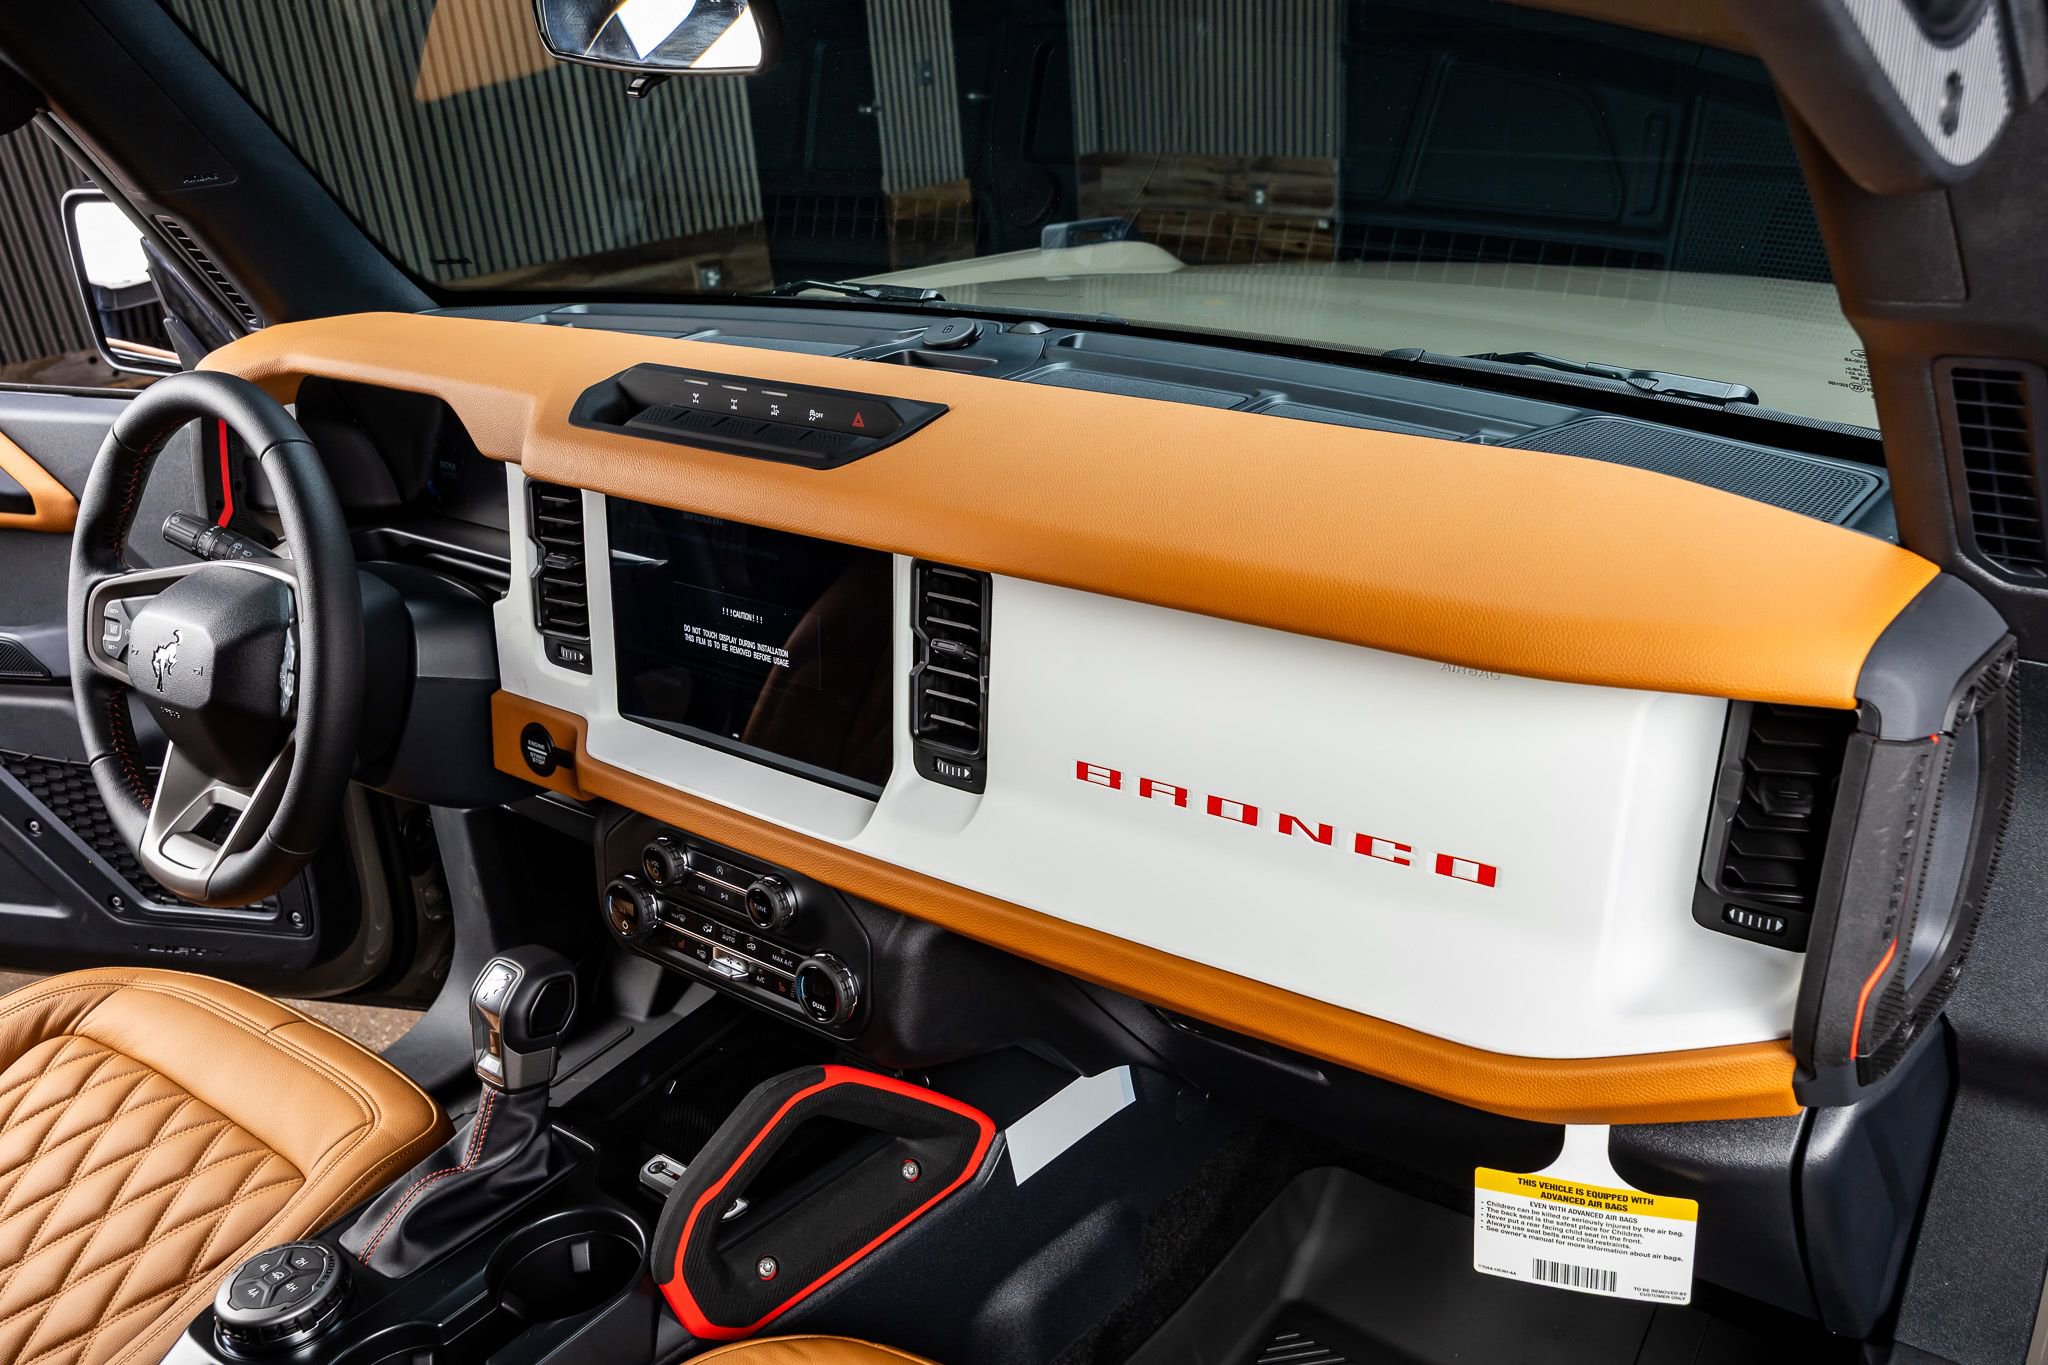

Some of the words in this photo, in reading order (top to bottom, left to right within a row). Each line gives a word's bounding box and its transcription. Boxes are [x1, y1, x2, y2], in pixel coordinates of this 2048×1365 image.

[684, 624, 691, 632] DO
[692, 626, 701, 636] NOT
[702, 629, 718, 640] TOUCH
[719, 633, 737, 644] DISPLAY
[739, 638, 756, 650] DURING
[757, 643, 789, 658] INSTALLATION
[684, 633, 694, 643] THIS
[696, 636, 706, 646] FILM
[707, 639, 712, 647] IS
[714, 641, 720, 649] TO
[722, 643, 728, 652] BE
[730, 646, 752, 658] REMOVED
[753, 652, 772, 663] BEFORE
[773, 656, 790, 668] USAGE
[528, 740, 546, 750] ENGINE
[1074, 759, 1499, 888] BRONCO
[754, 903, 767, 913] TUNE
[722, 934, 736, 944] AUTO
[772, 954, 784, 963] MAX
[784, 959, 793, 968] A/C
[756, 976, 765, 984] A/C
[812, 1001, 827, 1012] DUAL
[1518, 1177, 1537, 1187] THIS
[1539, 1181, 1574, 1194] VEHICLE
[1576, 1187, 1584, 1196] IS
[1586, 1190, 1629, 1202] EQUIPPED
[1631, 1196, 1654, 1206] WITH
[1540, 1192, 1586, 1206] ADVANCED
[1588, 1200, 1602, 1208] AIR
[1605, 1202, 1628, 1212] BAGS
[1486, 1200, 1516, 1211] Children
[1542, 1210, 1560, 1219] killed
[1572, 1215, 1604, 1227] seriously
[1606, 1222, 1630, 1231] injured
[1668, 1230, 1684, 1238] bag.
[1501, 1209, 1517, 1217] back
[1542, 1216, 1554, 1224] the
[1556, 1220, 1578, 1228] safest
[1579, 1223, 1598, 1232] place
[1612, 1230, 1644, 1238] Children.
[1530, 1201, 1547, 1210] EVEN
[1548, 1204, 1566, 1213] WITH
[1568, 1208, 1604, 1219] ADVANCED
[1619, 1216, 1638, 1224] BAGS
[1486, 1213, 1506, 1222] Never
[1508, 1216, 1519, 1224] put
[1542, 1223, 1564, 1233] facing
[1565, 1226, 1582, 1235] child
[1486, 1219, 1510, 1229] Always
[1542, 1230, 1560, 1238] belts
[1576, 1235, 1594, 1244] child
[1596, 1240, 1631, 1249] restraints.
[1486, 1225, 1499, 1233] See
[1500, 1229, 1527, 1238] owner's
[1528, 1234, 1554, 1243] manual
[1587, 1244, 1628, 1255] information
[1630, 1250, 1650, 1258] about
[1664, 1254, 1684, 1262] bags.
[295, 1257, 308, 1266] 2H
[316, 1255, 336, 1288] MODES
[248, 1288, 259, 1298] 4A
[285, 1282, 298, 1292] 4H
